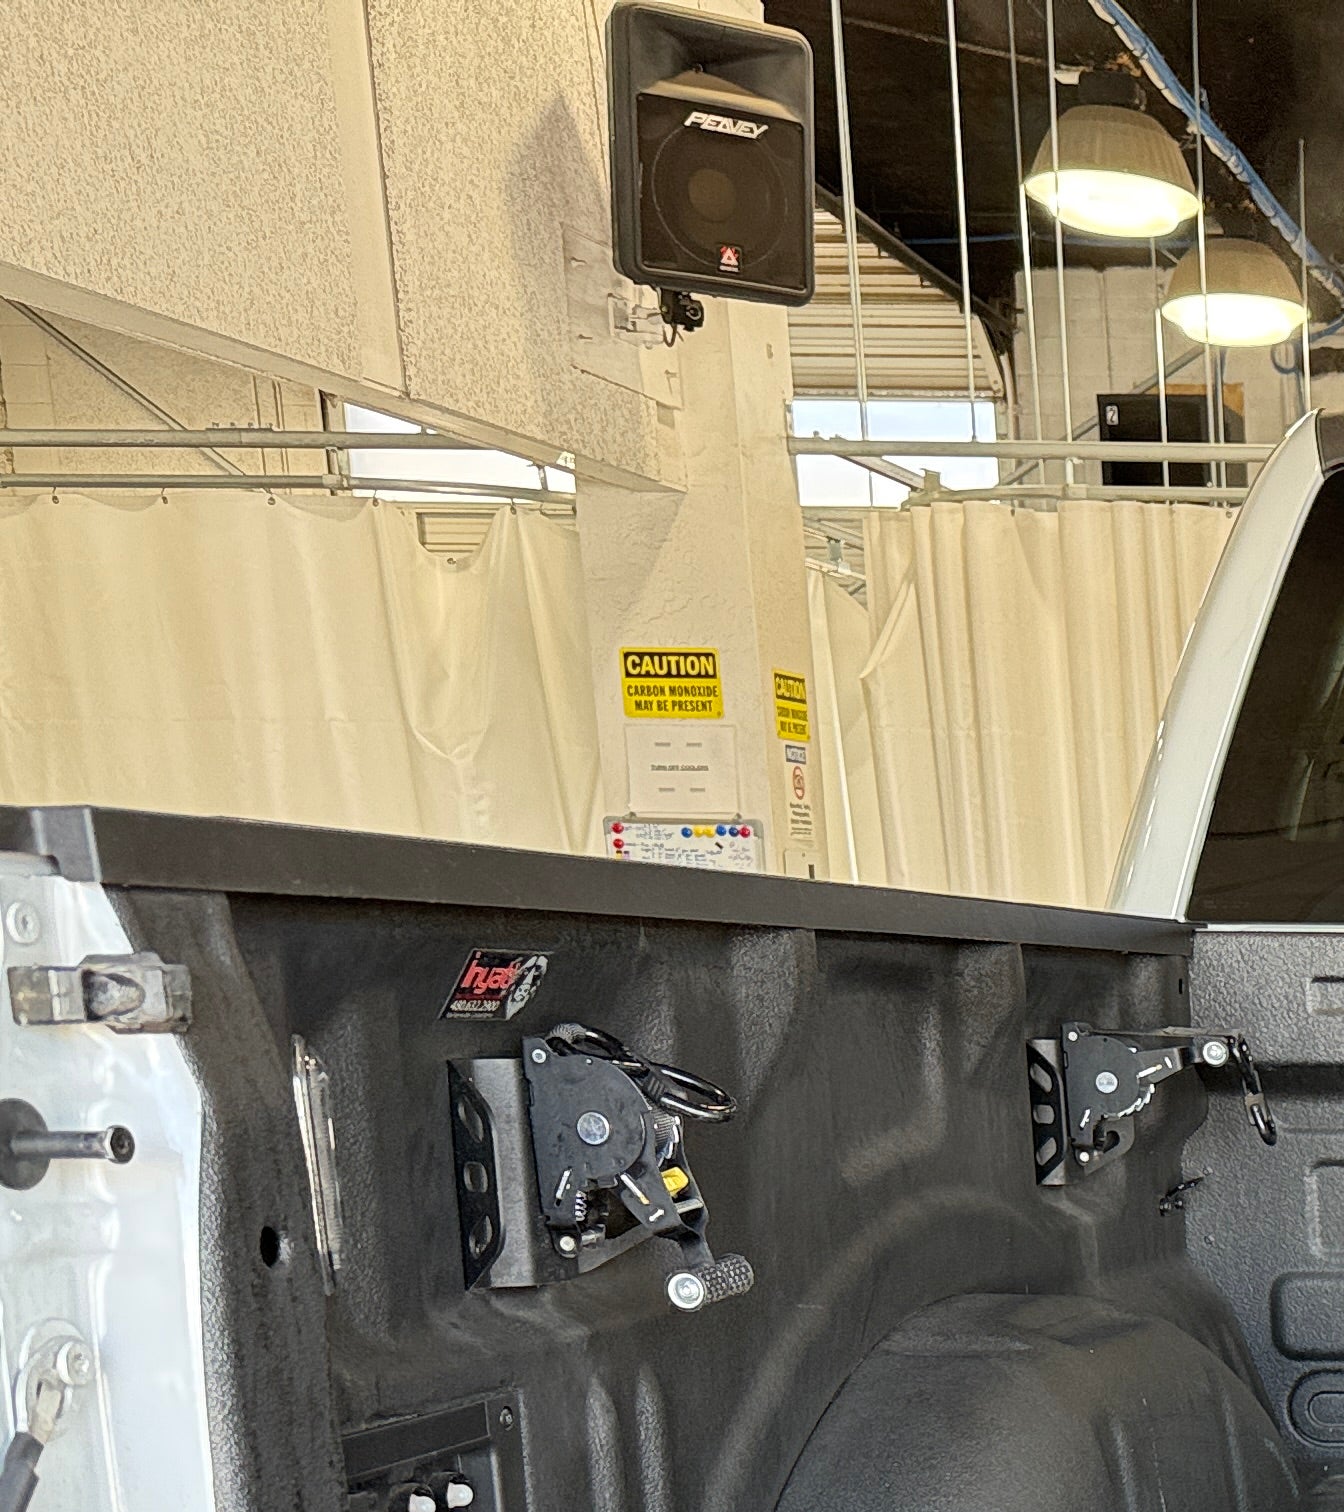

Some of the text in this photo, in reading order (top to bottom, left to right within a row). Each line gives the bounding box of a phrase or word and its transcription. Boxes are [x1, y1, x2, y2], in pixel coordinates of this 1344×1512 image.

[684, 111, 768, 139] PEAVEY
[627, 654, 715, 676] CAUTION
[627, 684, 718, 698] CARBON MONOXIDE
[634, 699, 714, 713] MAY BE PRESENT
